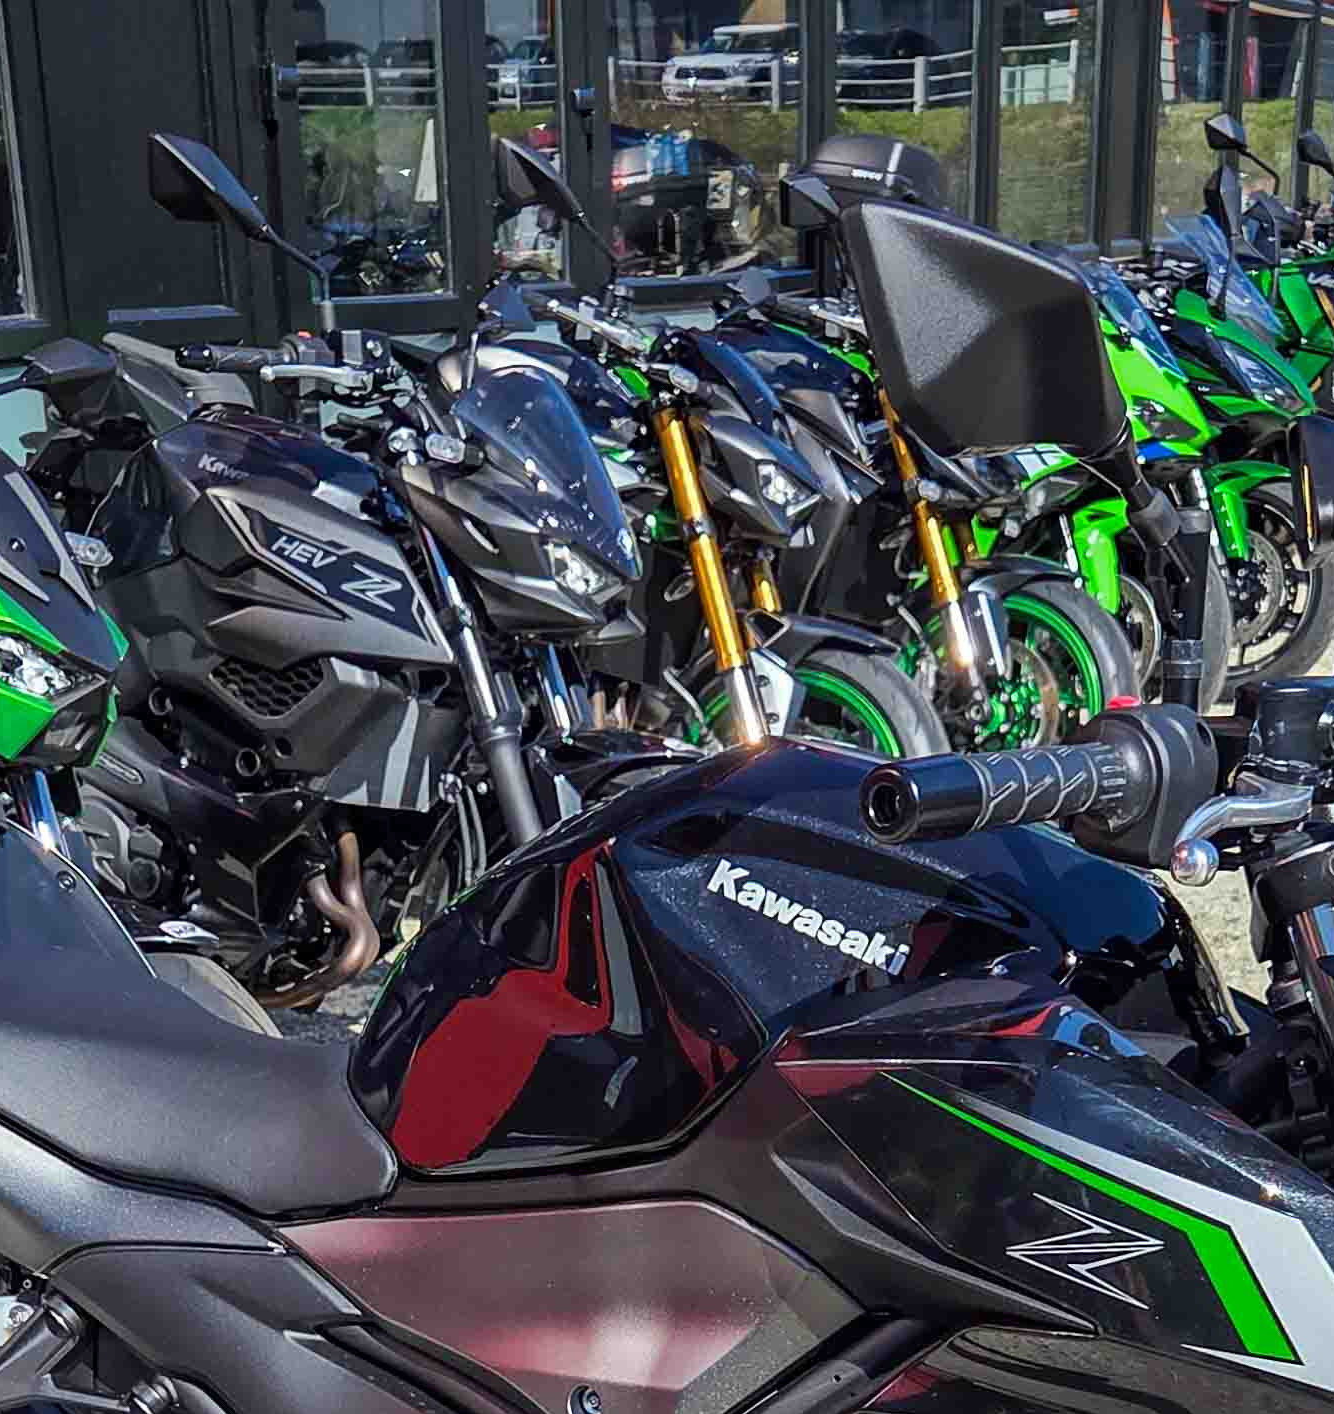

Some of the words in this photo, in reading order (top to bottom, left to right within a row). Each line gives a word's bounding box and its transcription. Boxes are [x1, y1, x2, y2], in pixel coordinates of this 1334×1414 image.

[271, 535, 338, 569] HEV
[706, 858, 910, 976] Kawasaki
[1005, 1192, 1165, 1310] Z
